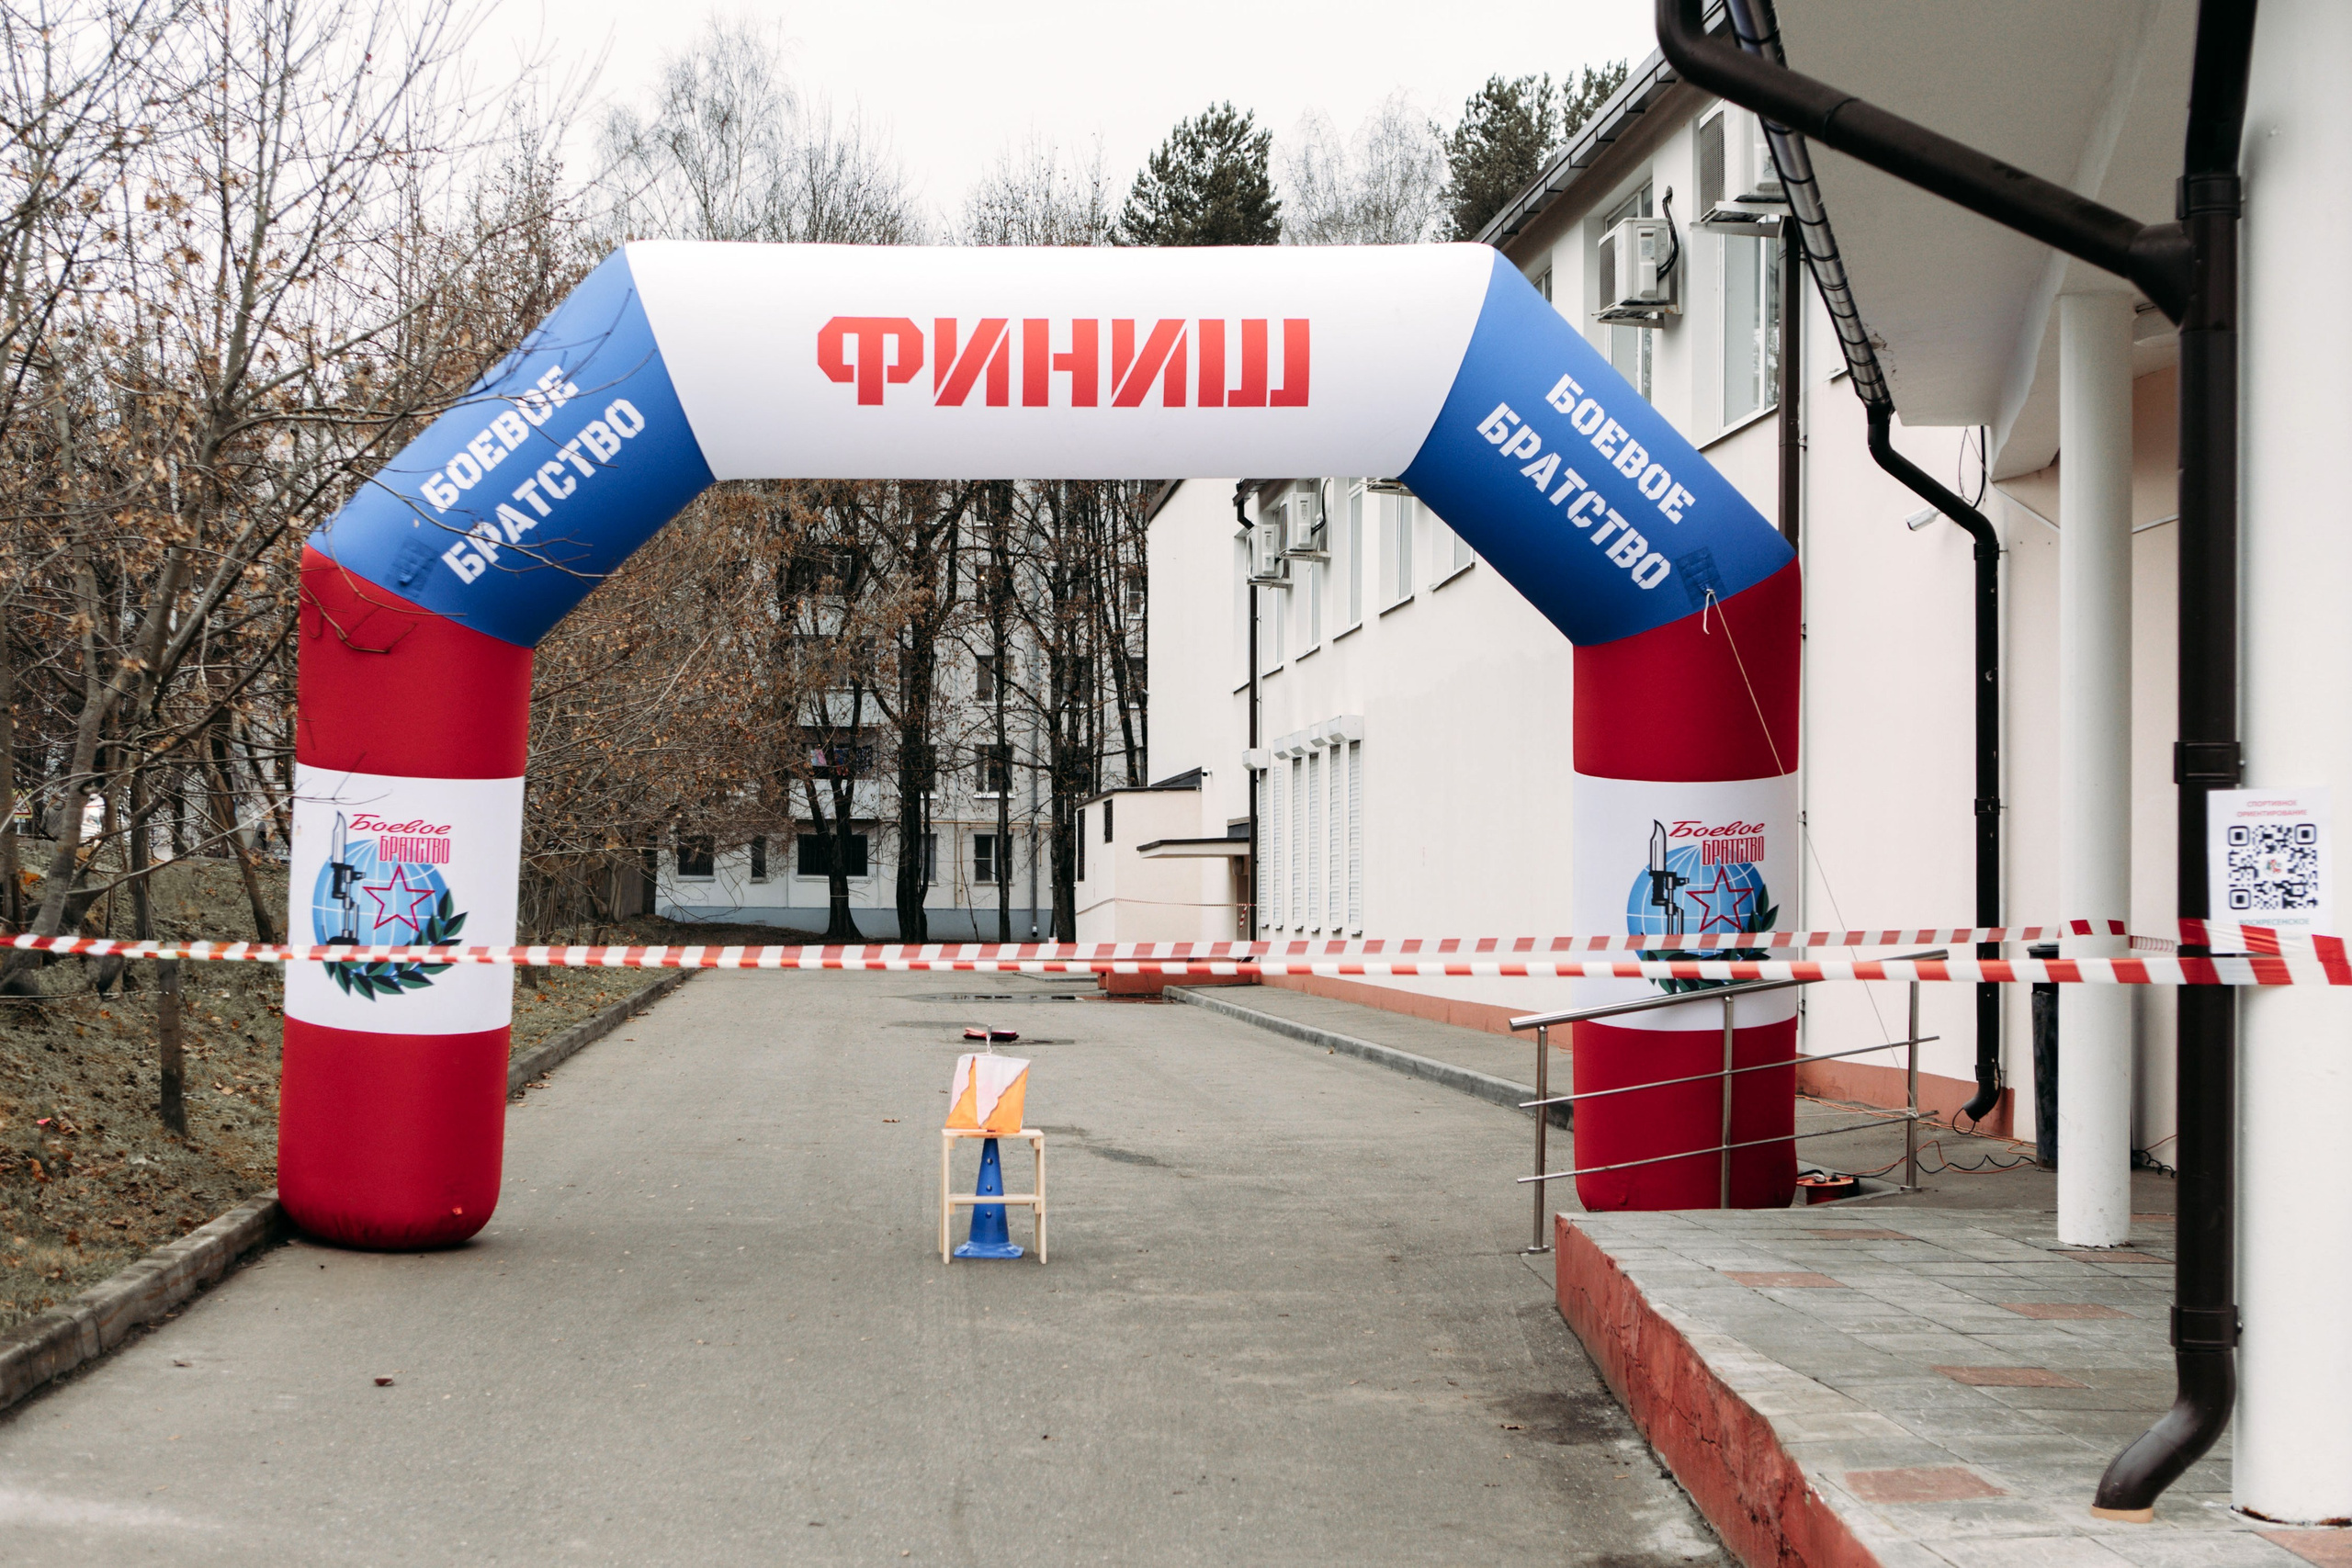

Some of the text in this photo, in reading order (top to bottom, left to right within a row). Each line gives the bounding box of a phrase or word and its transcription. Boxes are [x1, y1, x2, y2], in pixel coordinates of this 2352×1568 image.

[817, 316, 1310, 408] ФИНИШ
[419, 365, 580, 514] БОЕВОЕ
[1544, 373, 1696, 525] БОЕВОЕ
[441, 398, 645, 585] БРАТСТВО
[1476, 401, 1671, 590] БРАТСТВО
[348, 813, 452, 835] Боевое
[379, 835, 450, 864] БРАТСТВО
[1668, 820, 1765, 838] Боевое
[1702, 836, 1765, 866] БРАТСТВО
